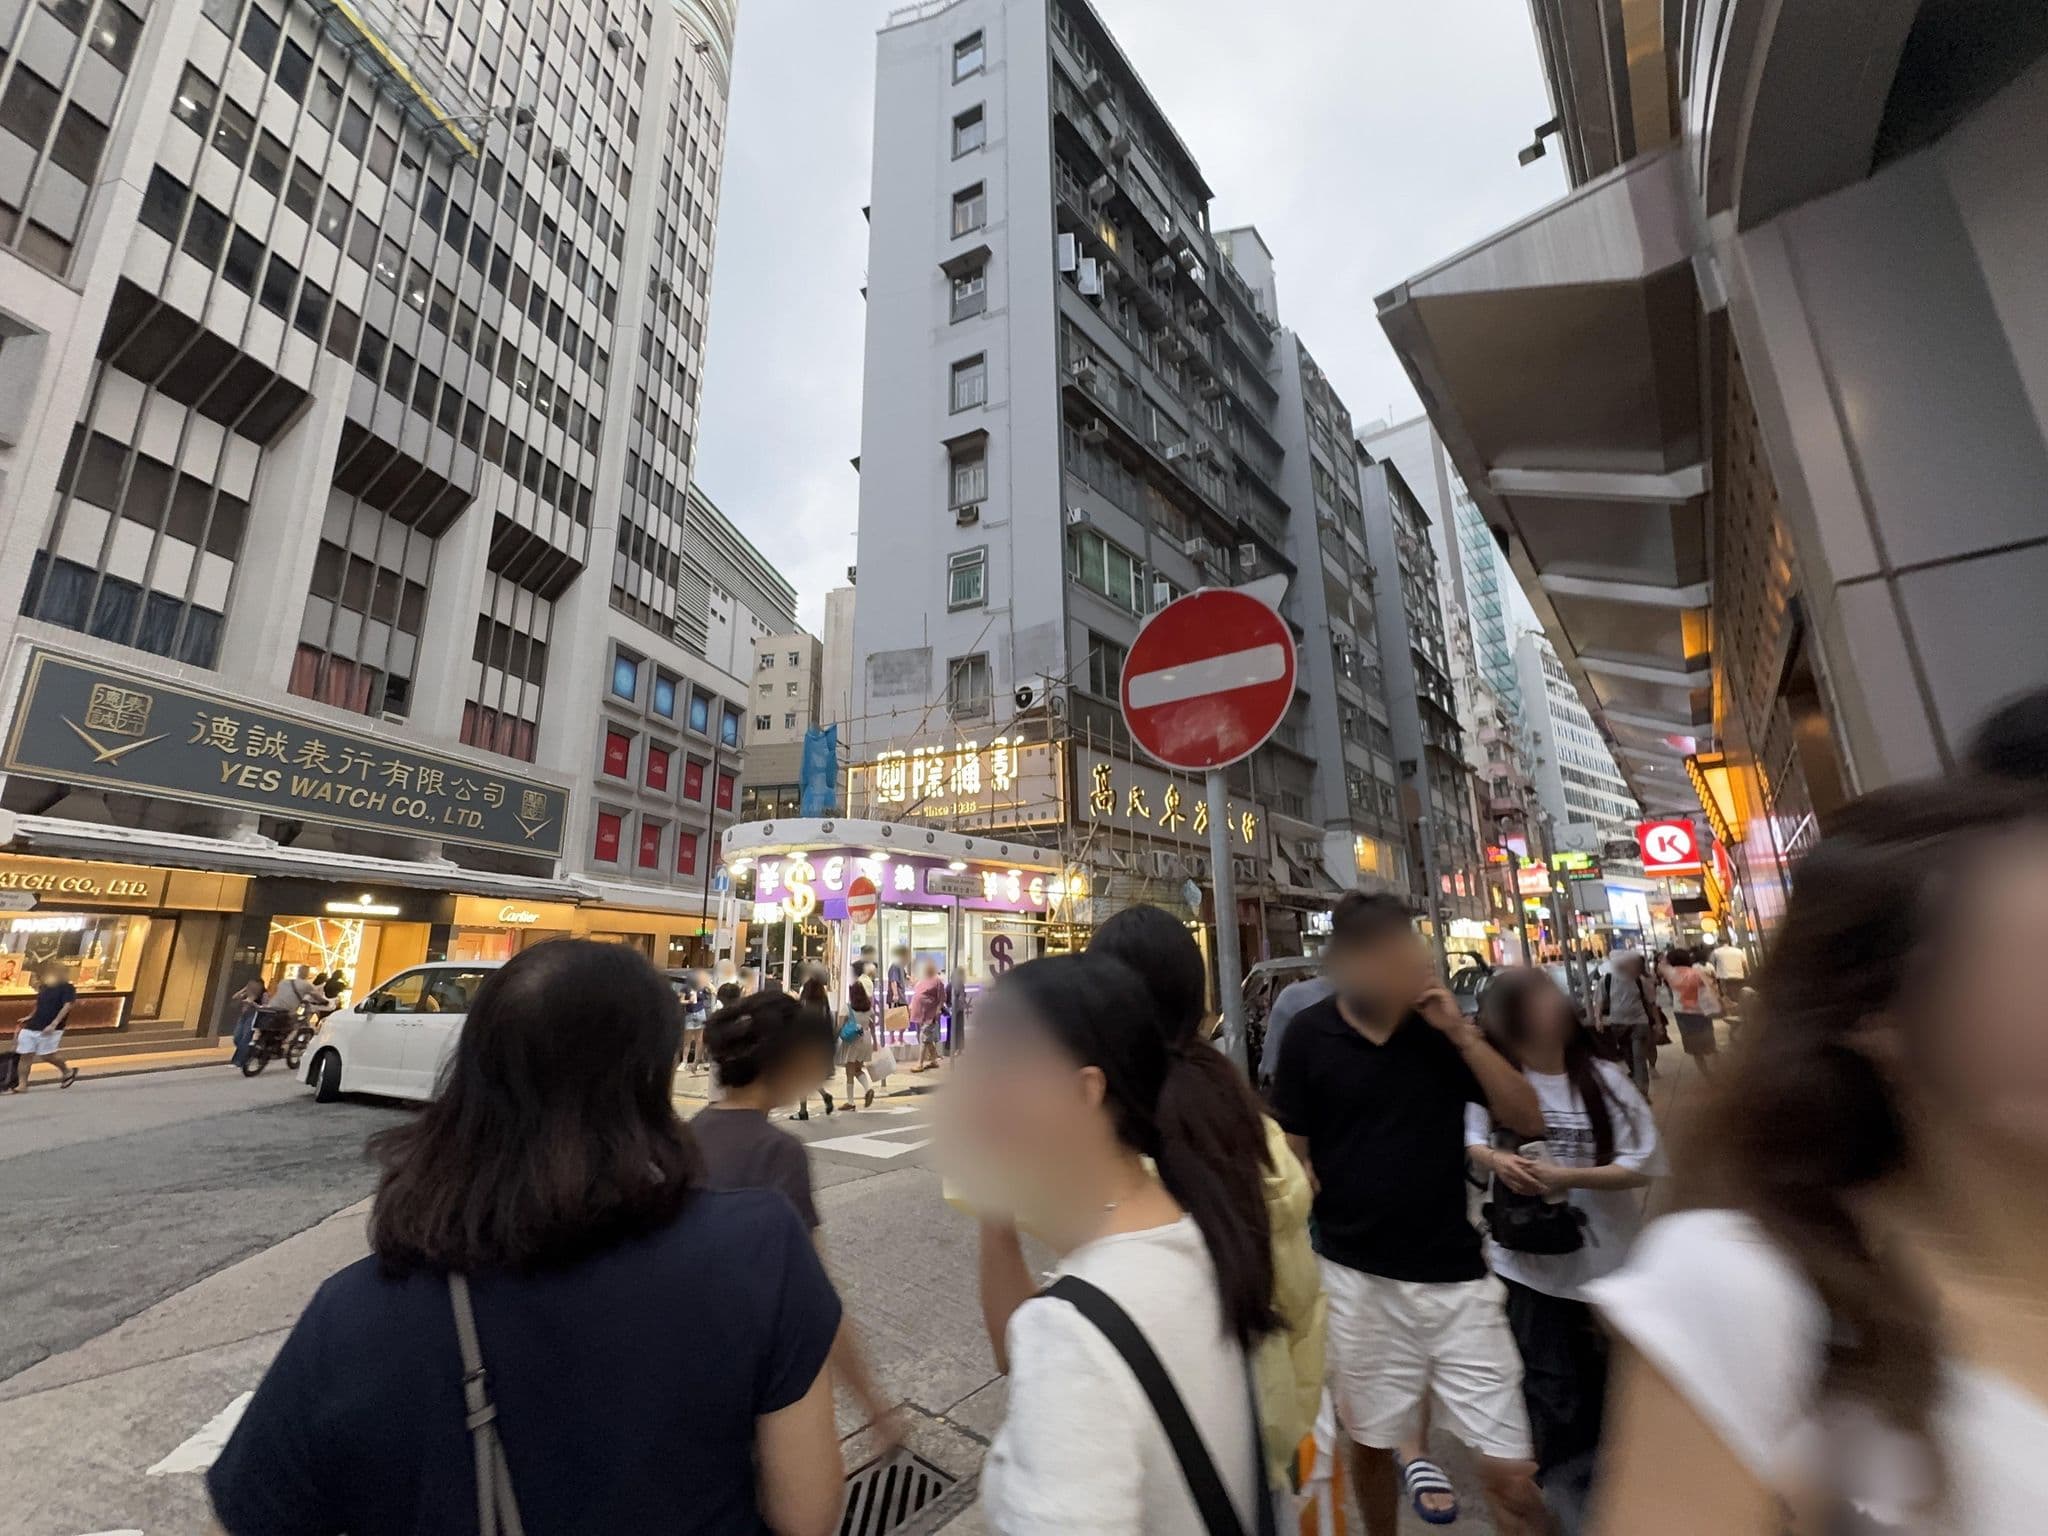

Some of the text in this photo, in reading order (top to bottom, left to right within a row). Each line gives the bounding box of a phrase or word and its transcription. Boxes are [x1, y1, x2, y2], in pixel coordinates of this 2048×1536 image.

[187, 711, 506, 809] 德誠表行有限公司
[219, 760, 486, 830] YES WATCH CO., LTD.
[106, 879, 149, 897] LTD.
[498, 905, 540, 924] Cartier
